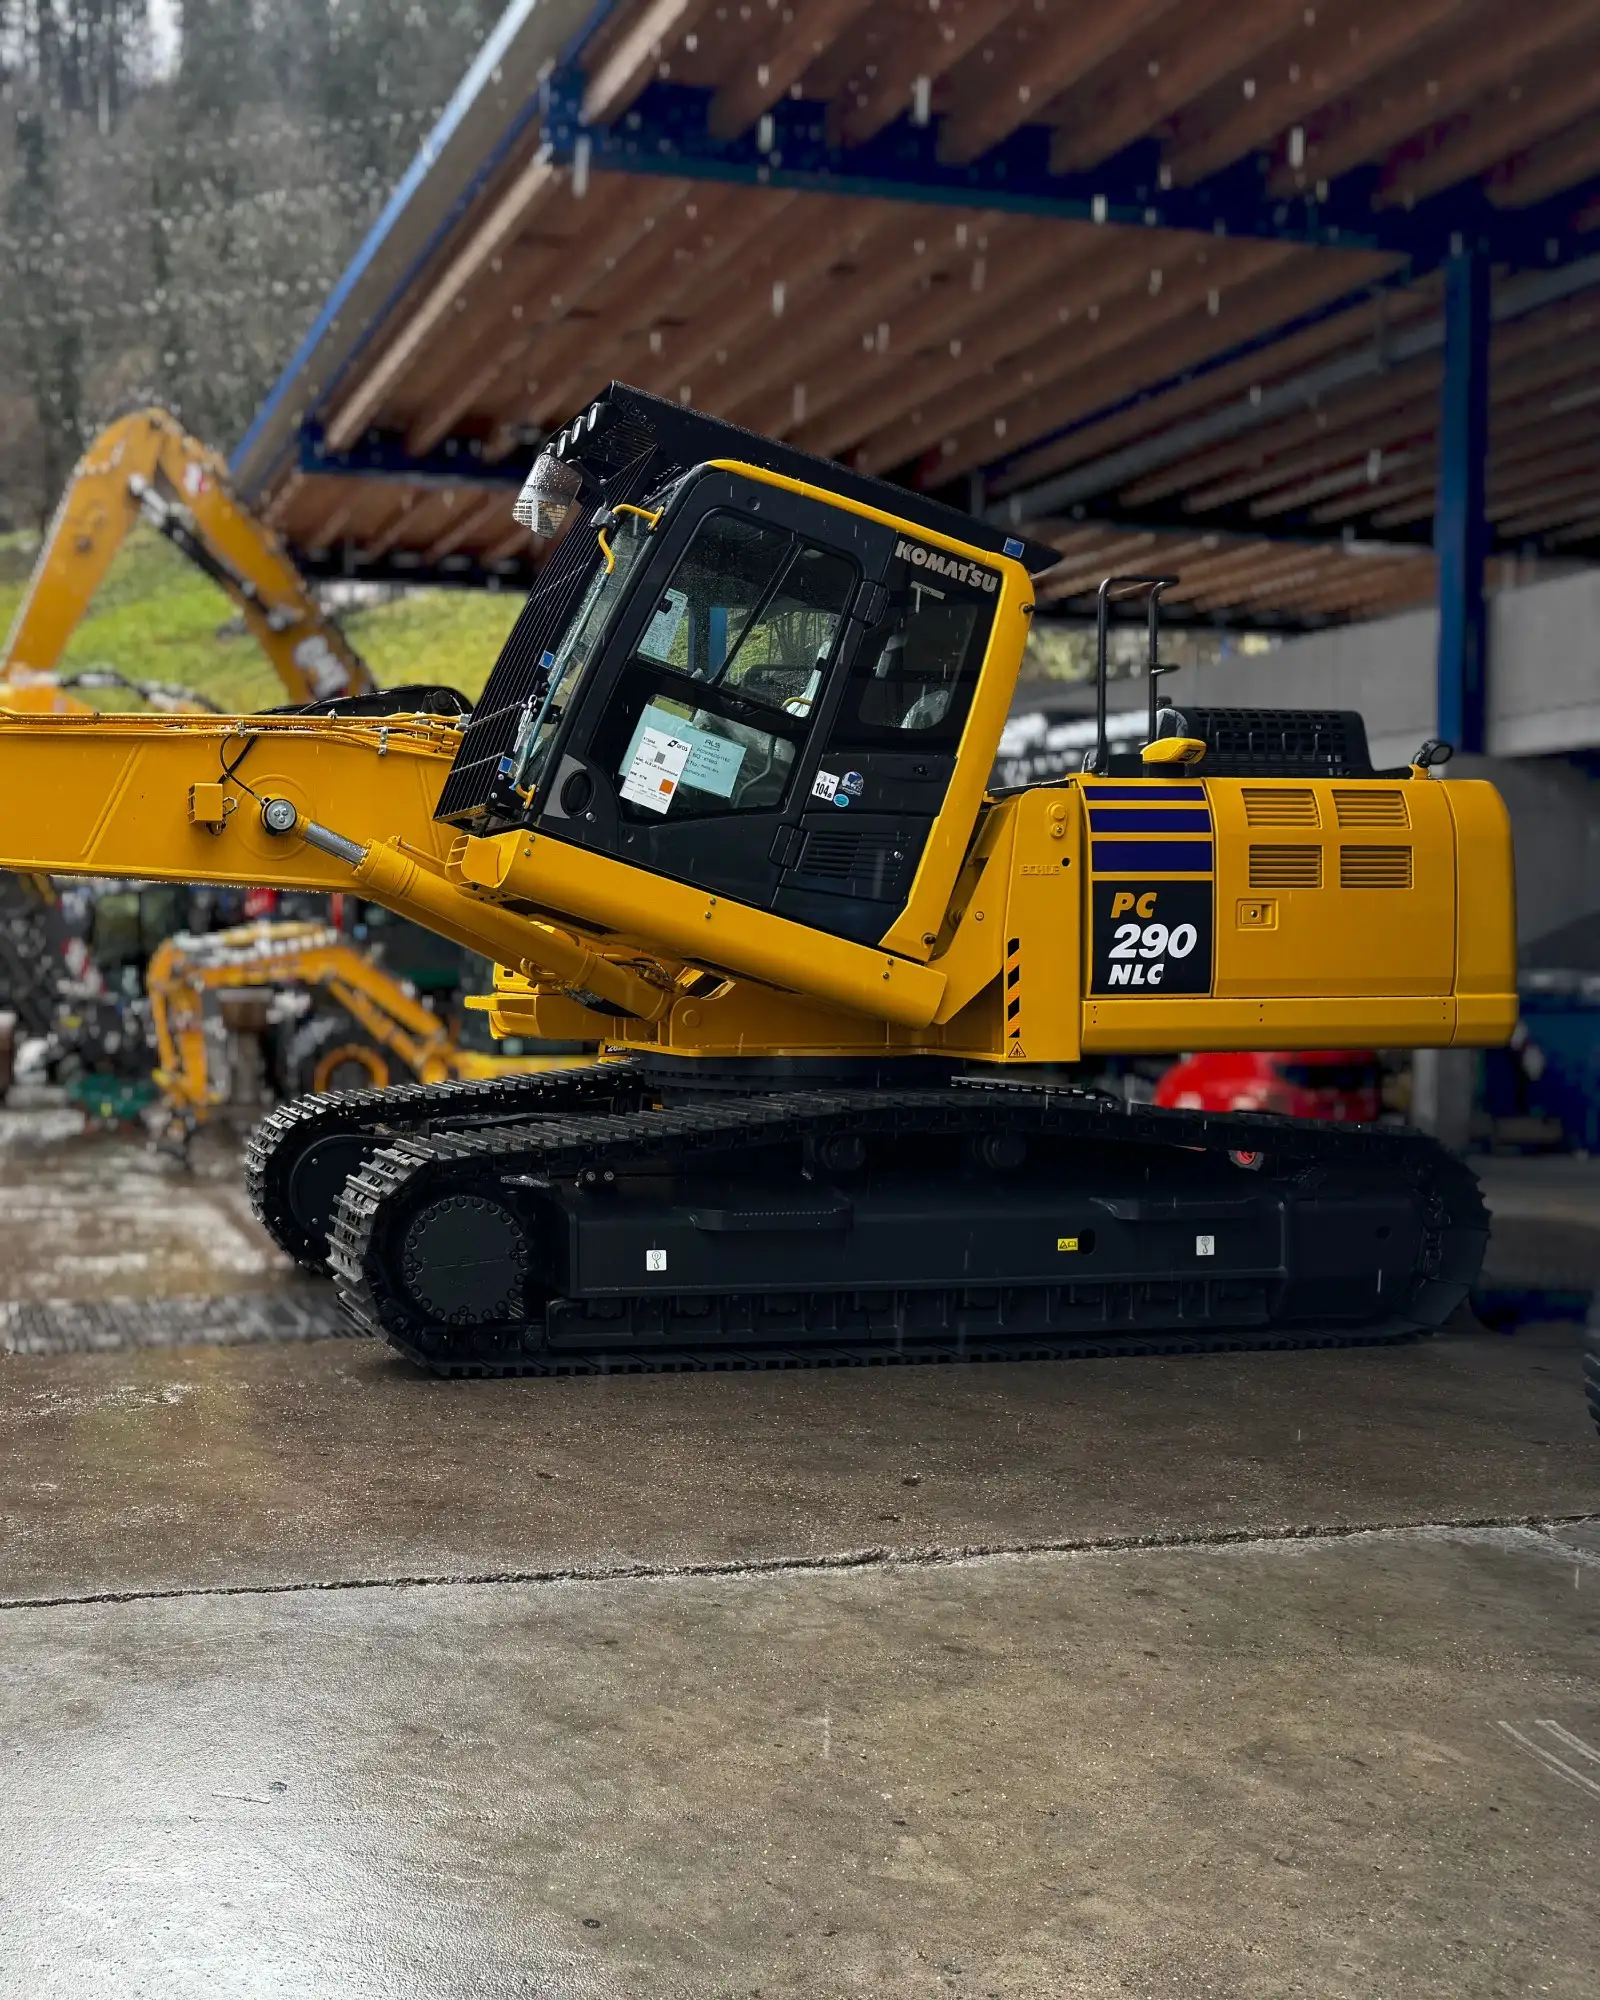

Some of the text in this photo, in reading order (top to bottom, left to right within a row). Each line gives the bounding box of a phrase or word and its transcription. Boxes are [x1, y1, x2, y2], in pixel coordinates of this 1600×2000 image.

[894, 540, 999, 593] KOMATSU
[815, 782, 830, 797] 104
[1110, 892, 1158, 919] PC
[1108, 923, 1198, 959] 290
[1107, 963, 1165, 986] NLC
